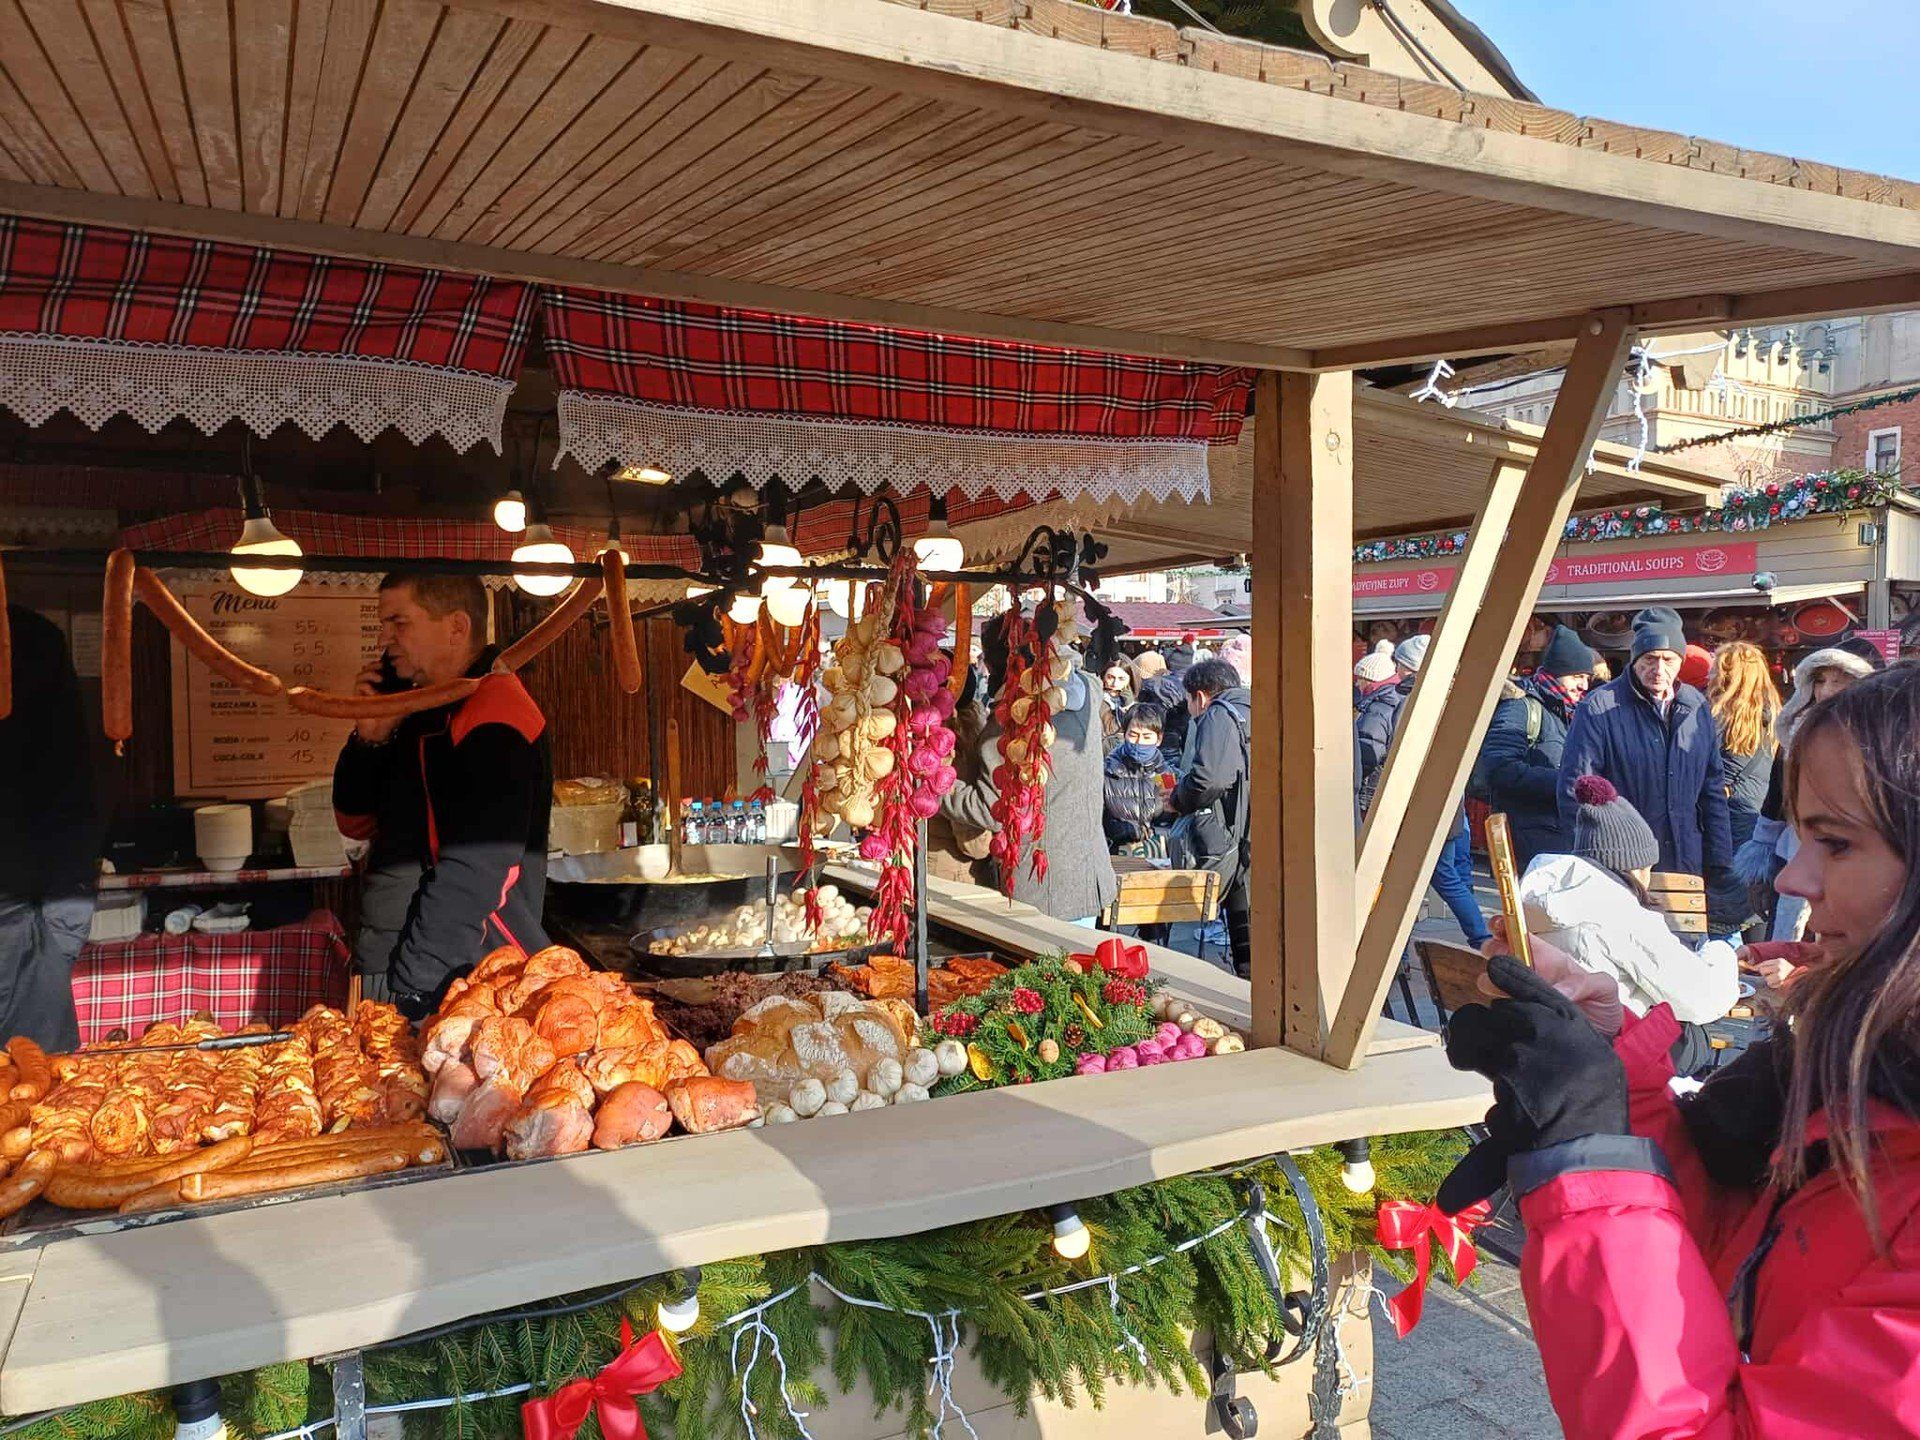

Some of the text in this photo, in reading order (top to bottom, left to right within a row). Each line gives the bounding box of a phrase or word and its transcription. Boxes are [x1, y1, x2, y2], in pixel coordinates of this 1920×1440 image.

[1567, 556, 1684, 577] TRADITIONAL SOUPS
[1389, 577, 1409, 589] ZUPY
[210, 590, 279, 614] Menu
